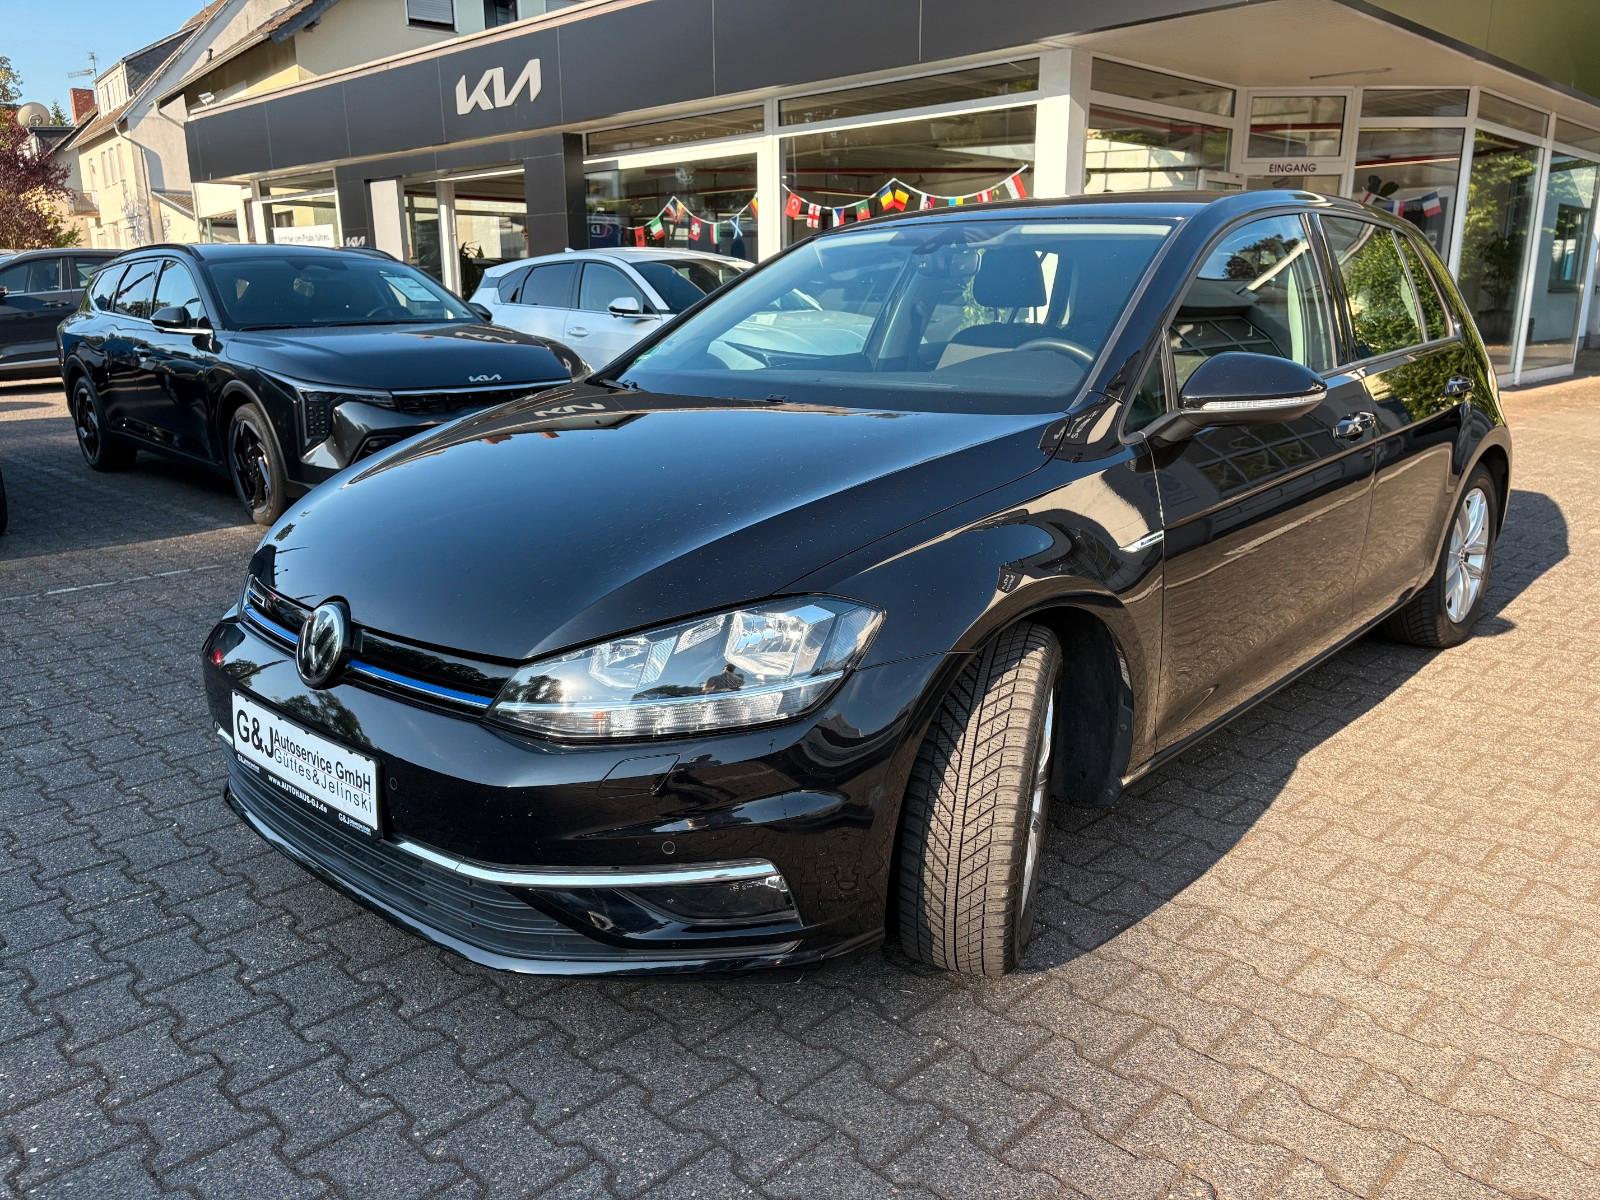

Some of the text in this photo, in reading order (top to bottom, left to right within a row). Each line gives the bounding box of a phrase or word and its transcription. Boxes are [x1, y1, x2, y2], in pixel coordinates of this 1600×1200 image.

[456, 58, 541, 115] KIA
[1269, 163, 1317, 173] EINGANG
[468, 373, 502, 382] KIA
[237, 709, 274, 758] G&J
[274, 730, 332, 775] Autoservice
[335, 761, 371, 793] GmbH
[274, 748, 372, 814] Güttes&Jelinski
